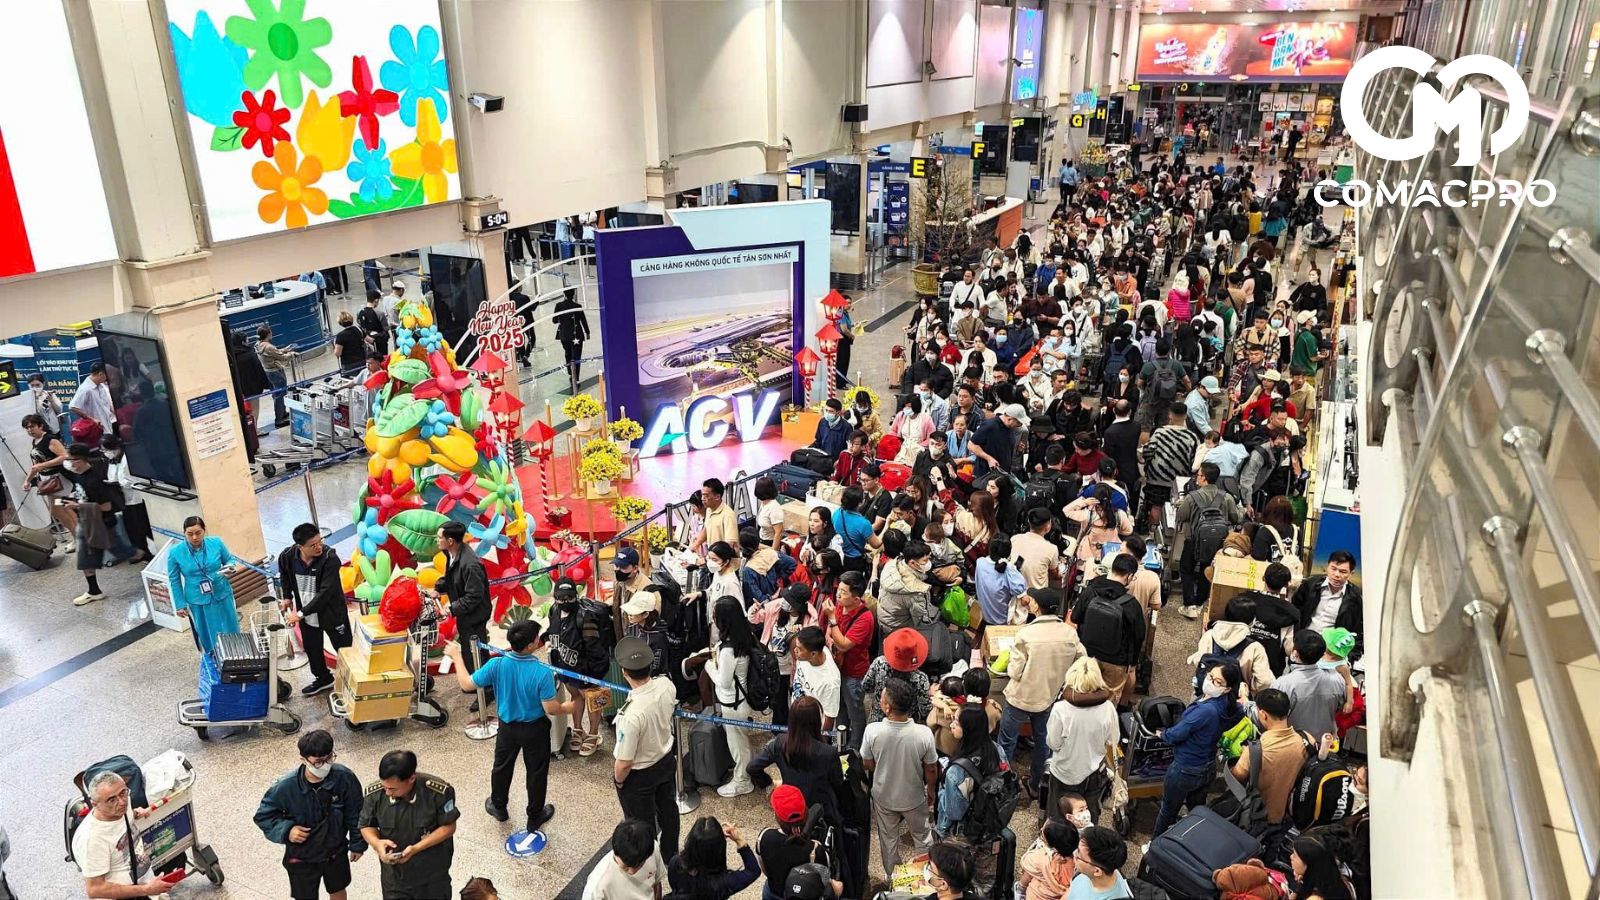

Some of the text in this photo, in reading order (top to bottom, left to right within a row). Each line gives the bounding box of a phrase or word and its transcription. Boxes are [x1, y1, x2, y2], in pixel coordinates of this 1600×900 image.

[1072, 114, 1083, 127] G
[1097, 108, 1106, 119] H
[973, 143, 985, 158] F
[913, 159, 926, 176] E
[487, 213, 507, 226] 5:04
[662, 260, 683, 270] HÀNG
[685, 257, 710, 268] KHÔNG
[711, 254, 731, 267] QUỐC
[733, 252, 741, 264] TẾ
[743, 252, 757, 262] TÂN
[758, 251, 772, 261] SƠN
[773, 249, 792, 259] NHẤT
[476, 301, 516, 318] Happy
[469, 315, 526, 336] New Year
[478, 328, 524, 356] 2025
[639, 387, 780, 459] ACV
[682, 711, 697, 719] TIA
[1331, 777, 1349, 820] Wilson
